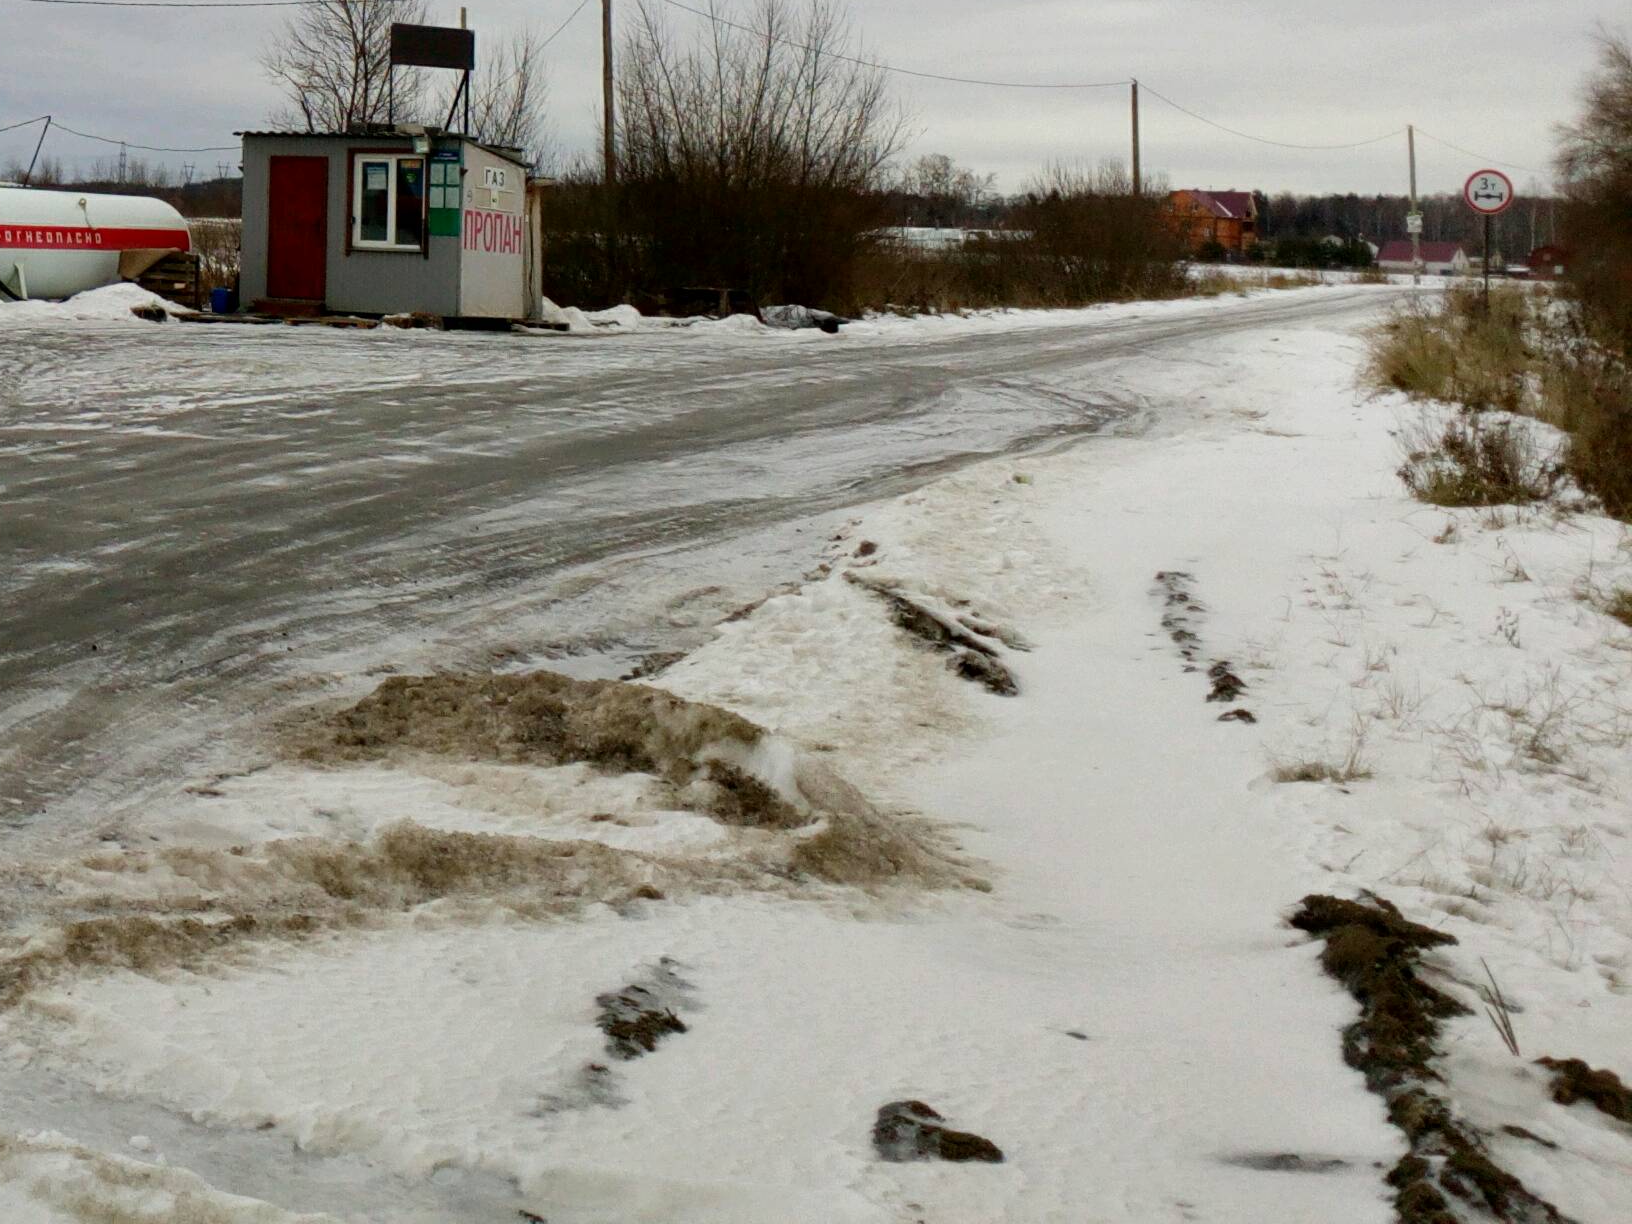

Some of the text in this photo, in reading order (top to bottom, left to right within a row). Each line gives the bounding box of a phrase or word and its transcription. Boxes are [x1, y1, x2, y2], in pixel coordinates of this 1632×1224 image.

[485, 169, 505, 187] ГАЗ
[1479, 177, 1489, 190] 3
[464, 210, 522, 254] ПРОПАН
